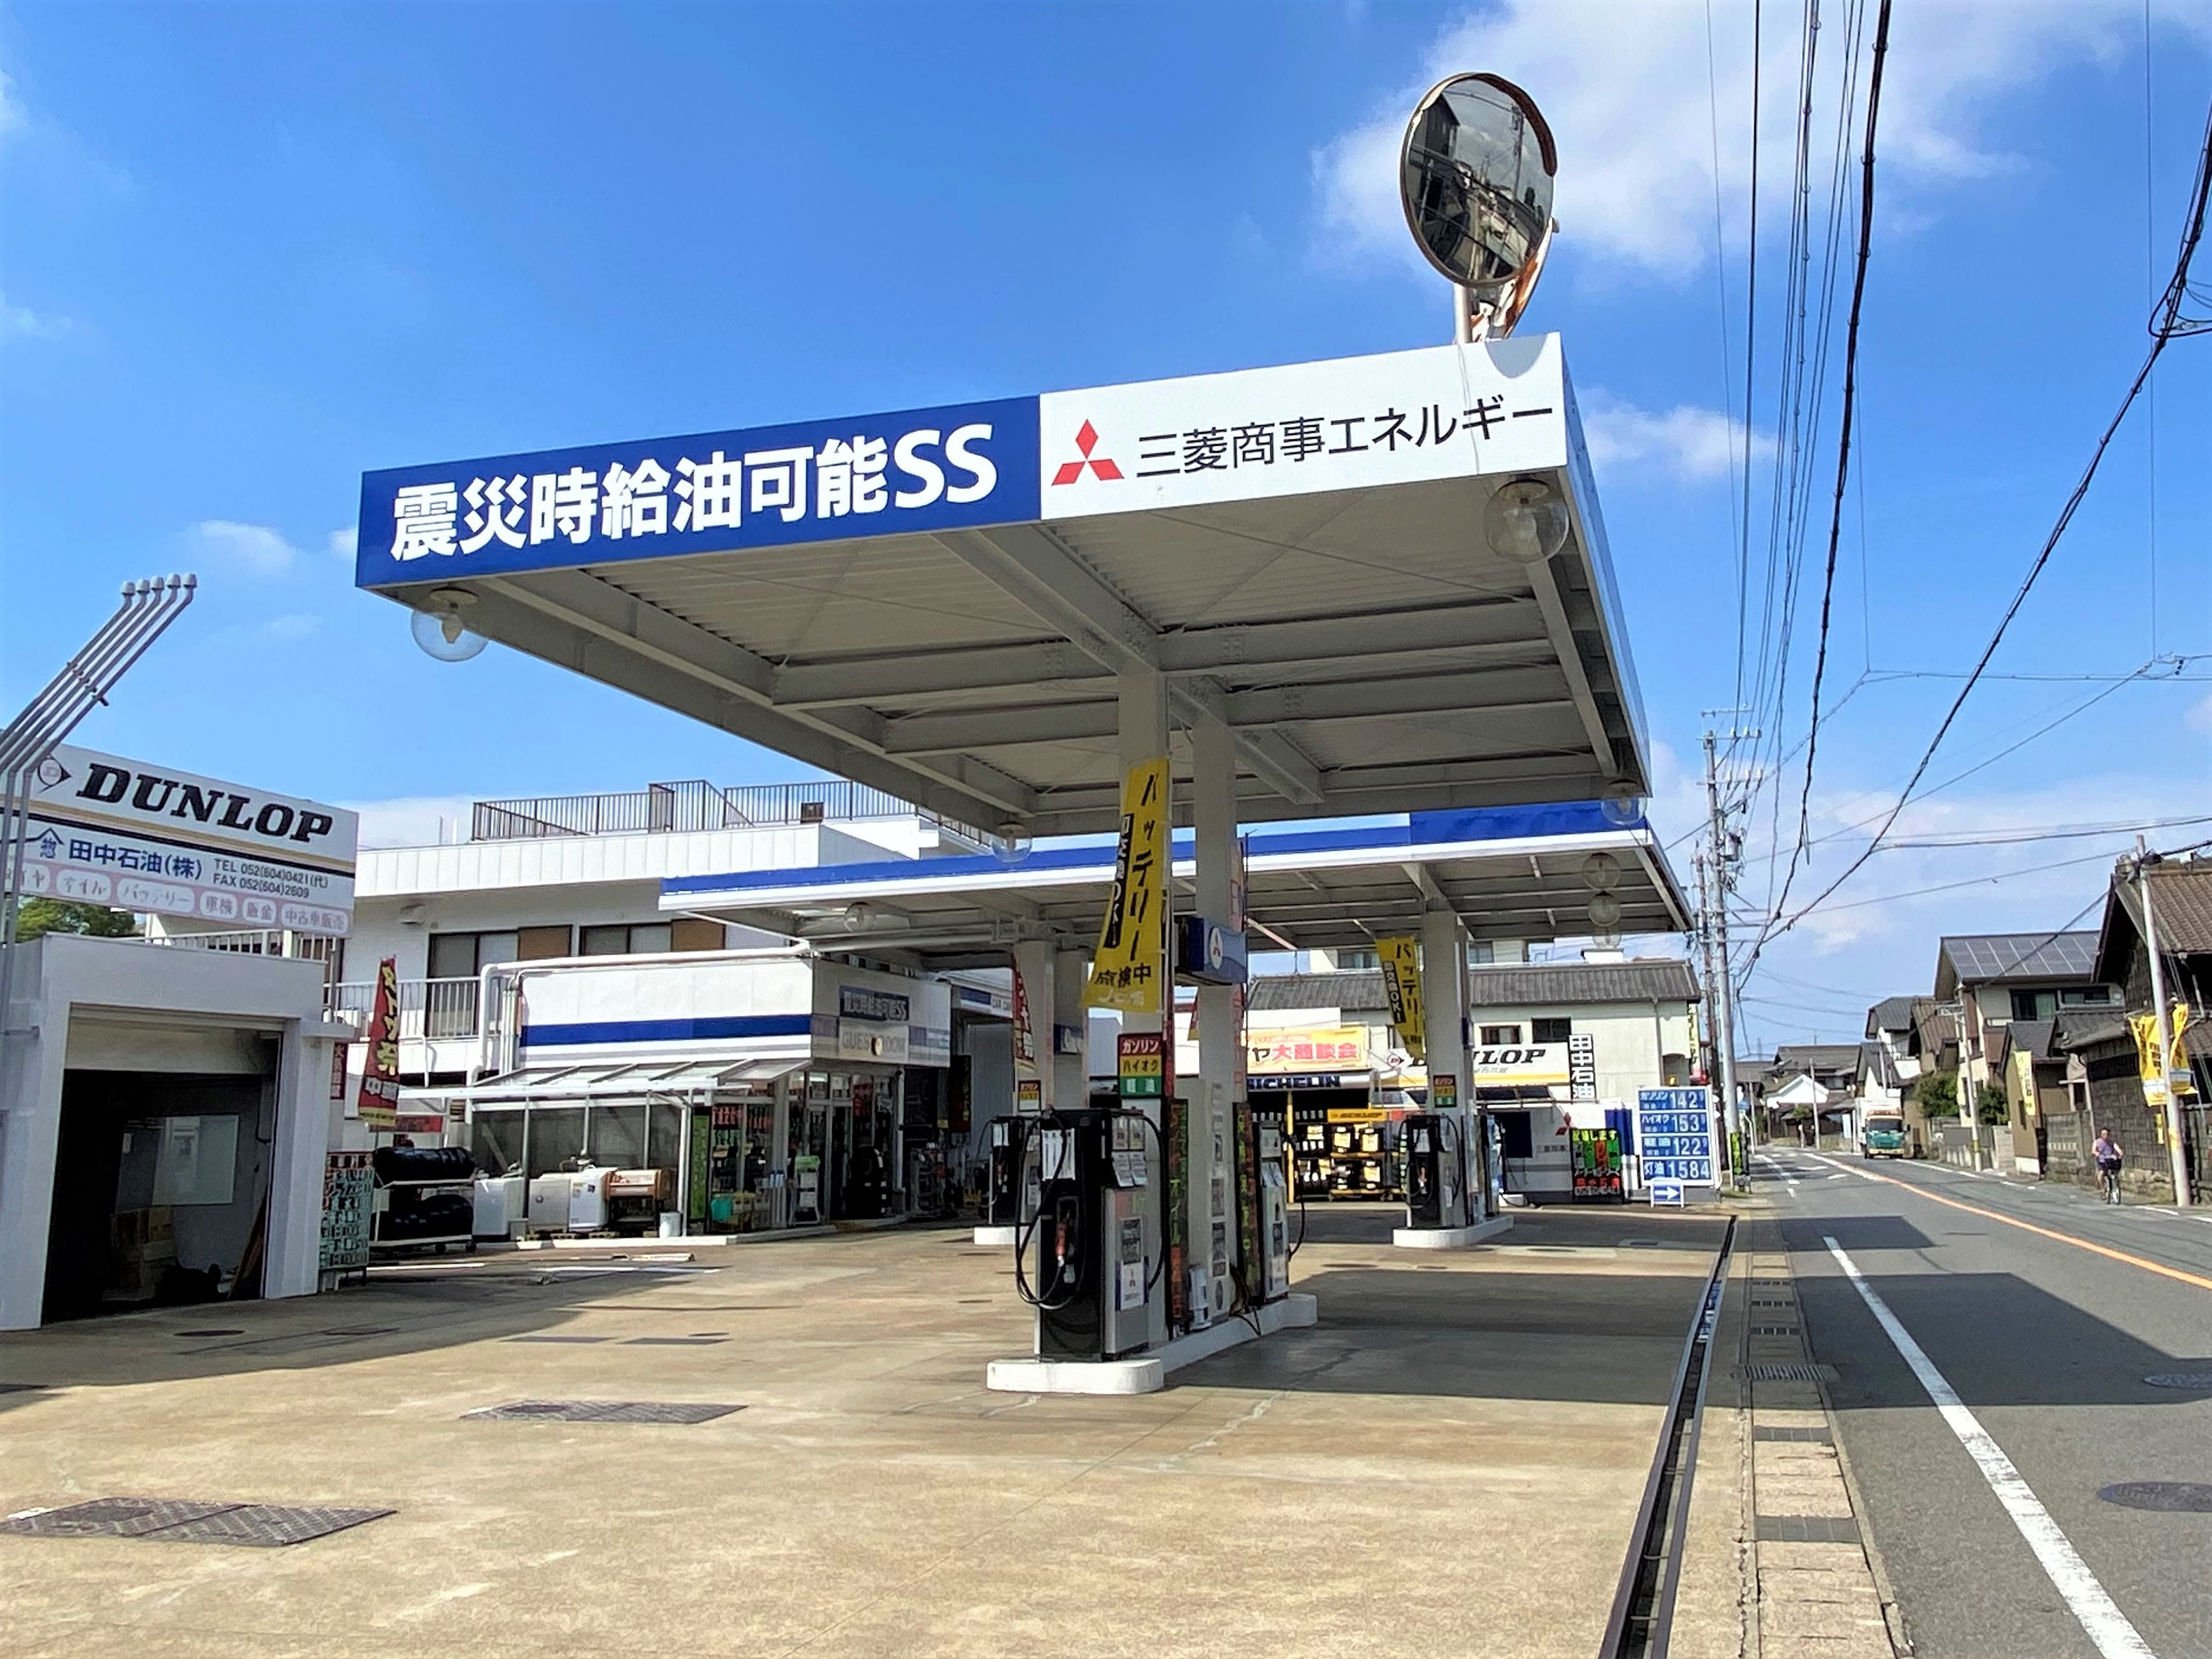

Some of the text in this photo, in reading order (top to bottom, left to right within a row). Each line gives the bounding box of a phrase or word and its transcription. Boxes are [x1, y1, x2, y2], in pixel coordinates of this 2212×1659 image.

[1136, 393, 1554, 480] 三菱商事エネルギー
[390, 423, 996, 560] 震災時給油可能SS
[76, 763, 333, 843] DUNLOP
[69, 839, 202, 880] 田中石油(株)
[214, 858, 239, 873] TEL
[213, 873, 236, 886] FAX
[1123, 1039, 1159, 1054] ガソリン
[1123, 1058, 1158, 1072] ハイオク
[1569, 1036, 1595, 1099] 田中石油
[1668, 1161, 1710, 1179] 1584
